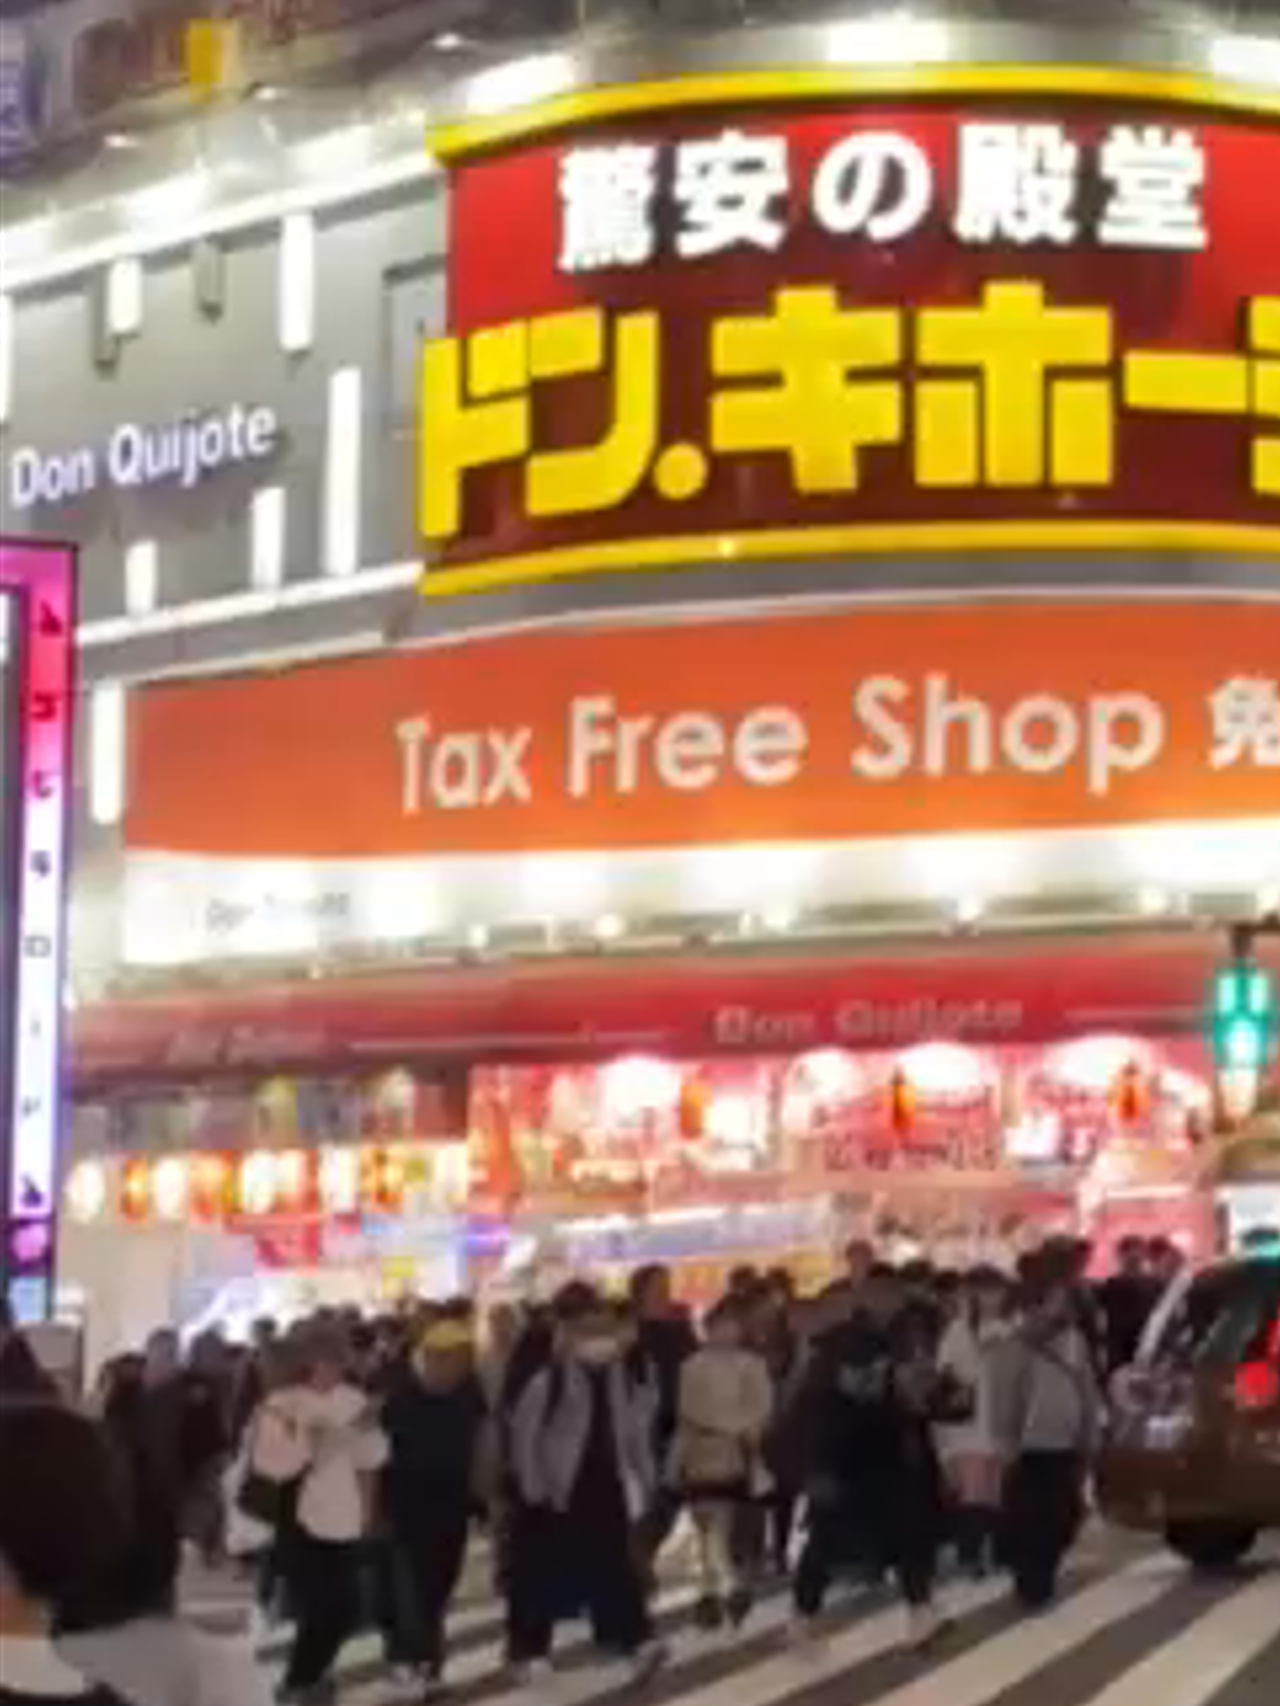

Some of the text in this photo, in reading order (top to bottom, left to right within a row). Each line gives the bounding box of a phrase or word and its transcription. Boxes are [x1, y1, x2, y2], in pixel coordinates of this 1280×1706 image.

[556, 121, 1208, 271] 驚安の殿堂
[9, 397, 280, 508] Don Quijote
[396, 672, 1167, 816] Tax Free Shop
